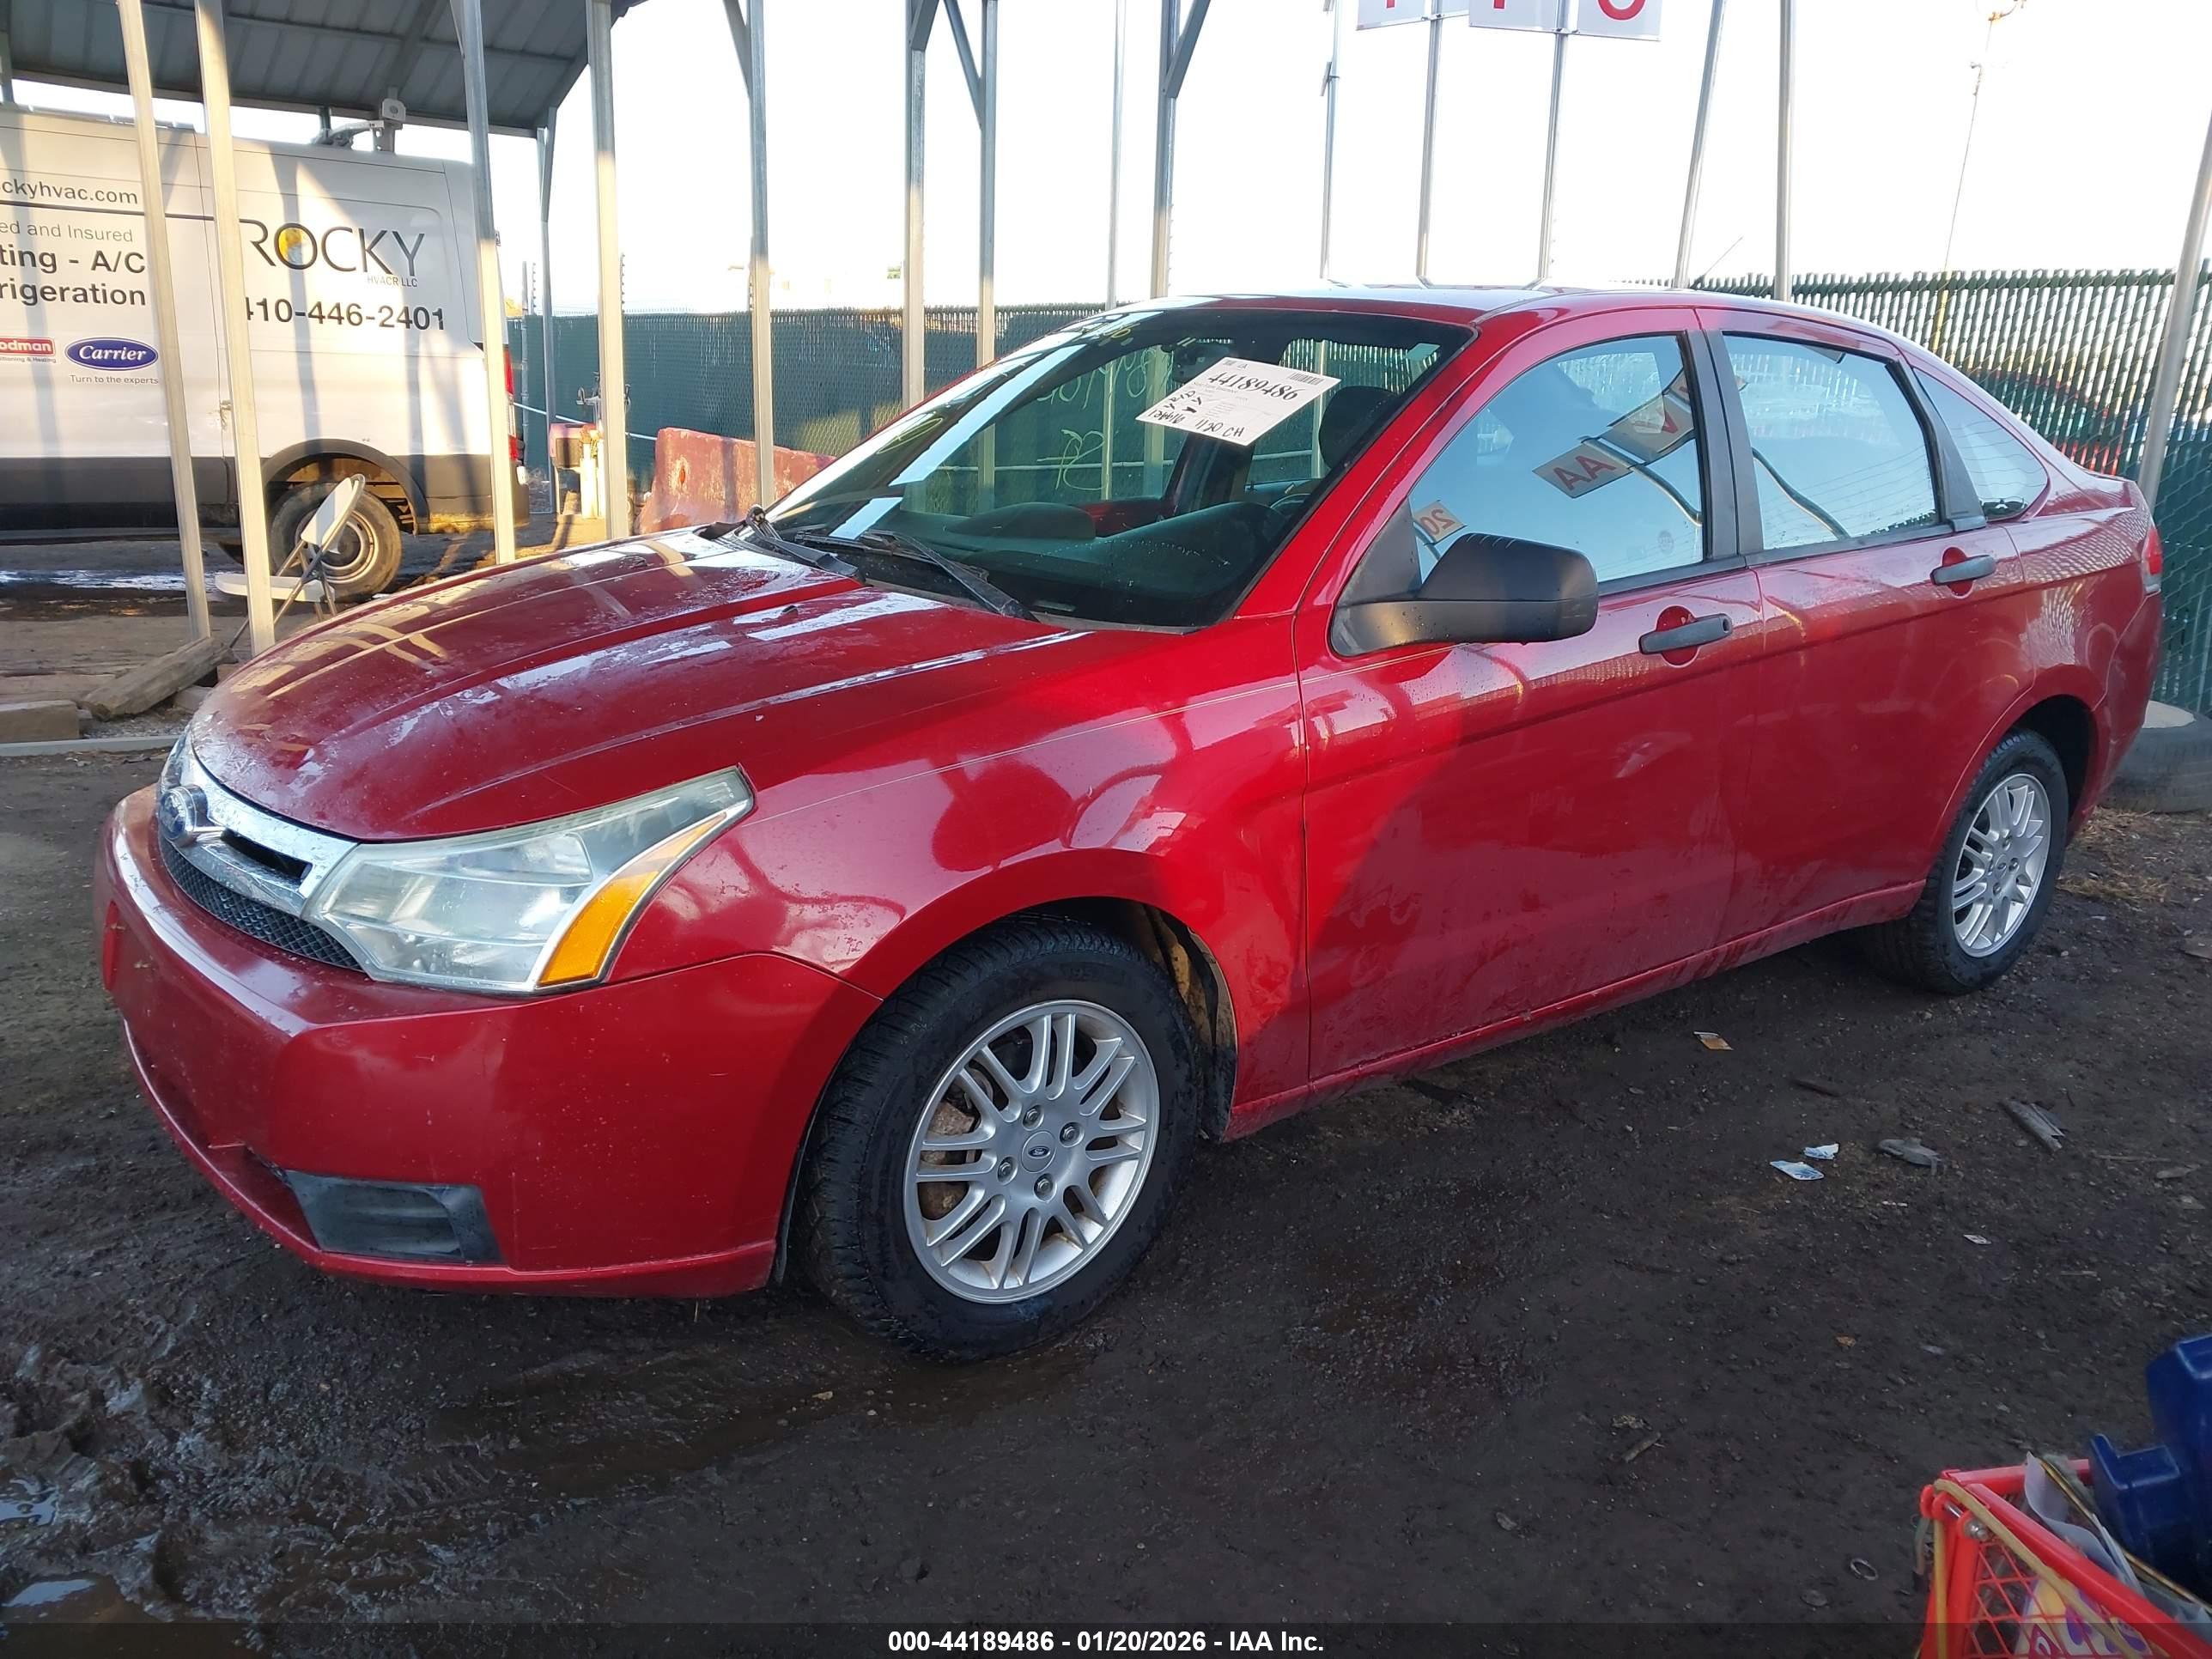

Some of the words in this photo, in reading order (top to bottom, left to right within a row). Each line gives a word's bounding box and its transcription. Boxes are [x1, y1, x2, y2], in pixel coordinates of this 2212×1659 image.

[0, 179, 138, 204] ckyhvac.com
[27, 224, 61, 237] and
[68, 225, 133, 242] Insured
[239, 218, 425, 276] ROCKY
[91, 250, 146, 274] A/C
[401, 277, 418, 288] LLC
[79, 345, 146, 362] Carrier
[70, 374, 93, 384] Turn
[124, 377, 159, 386] experts
[1208, 371, 1303, 401] 44189486
